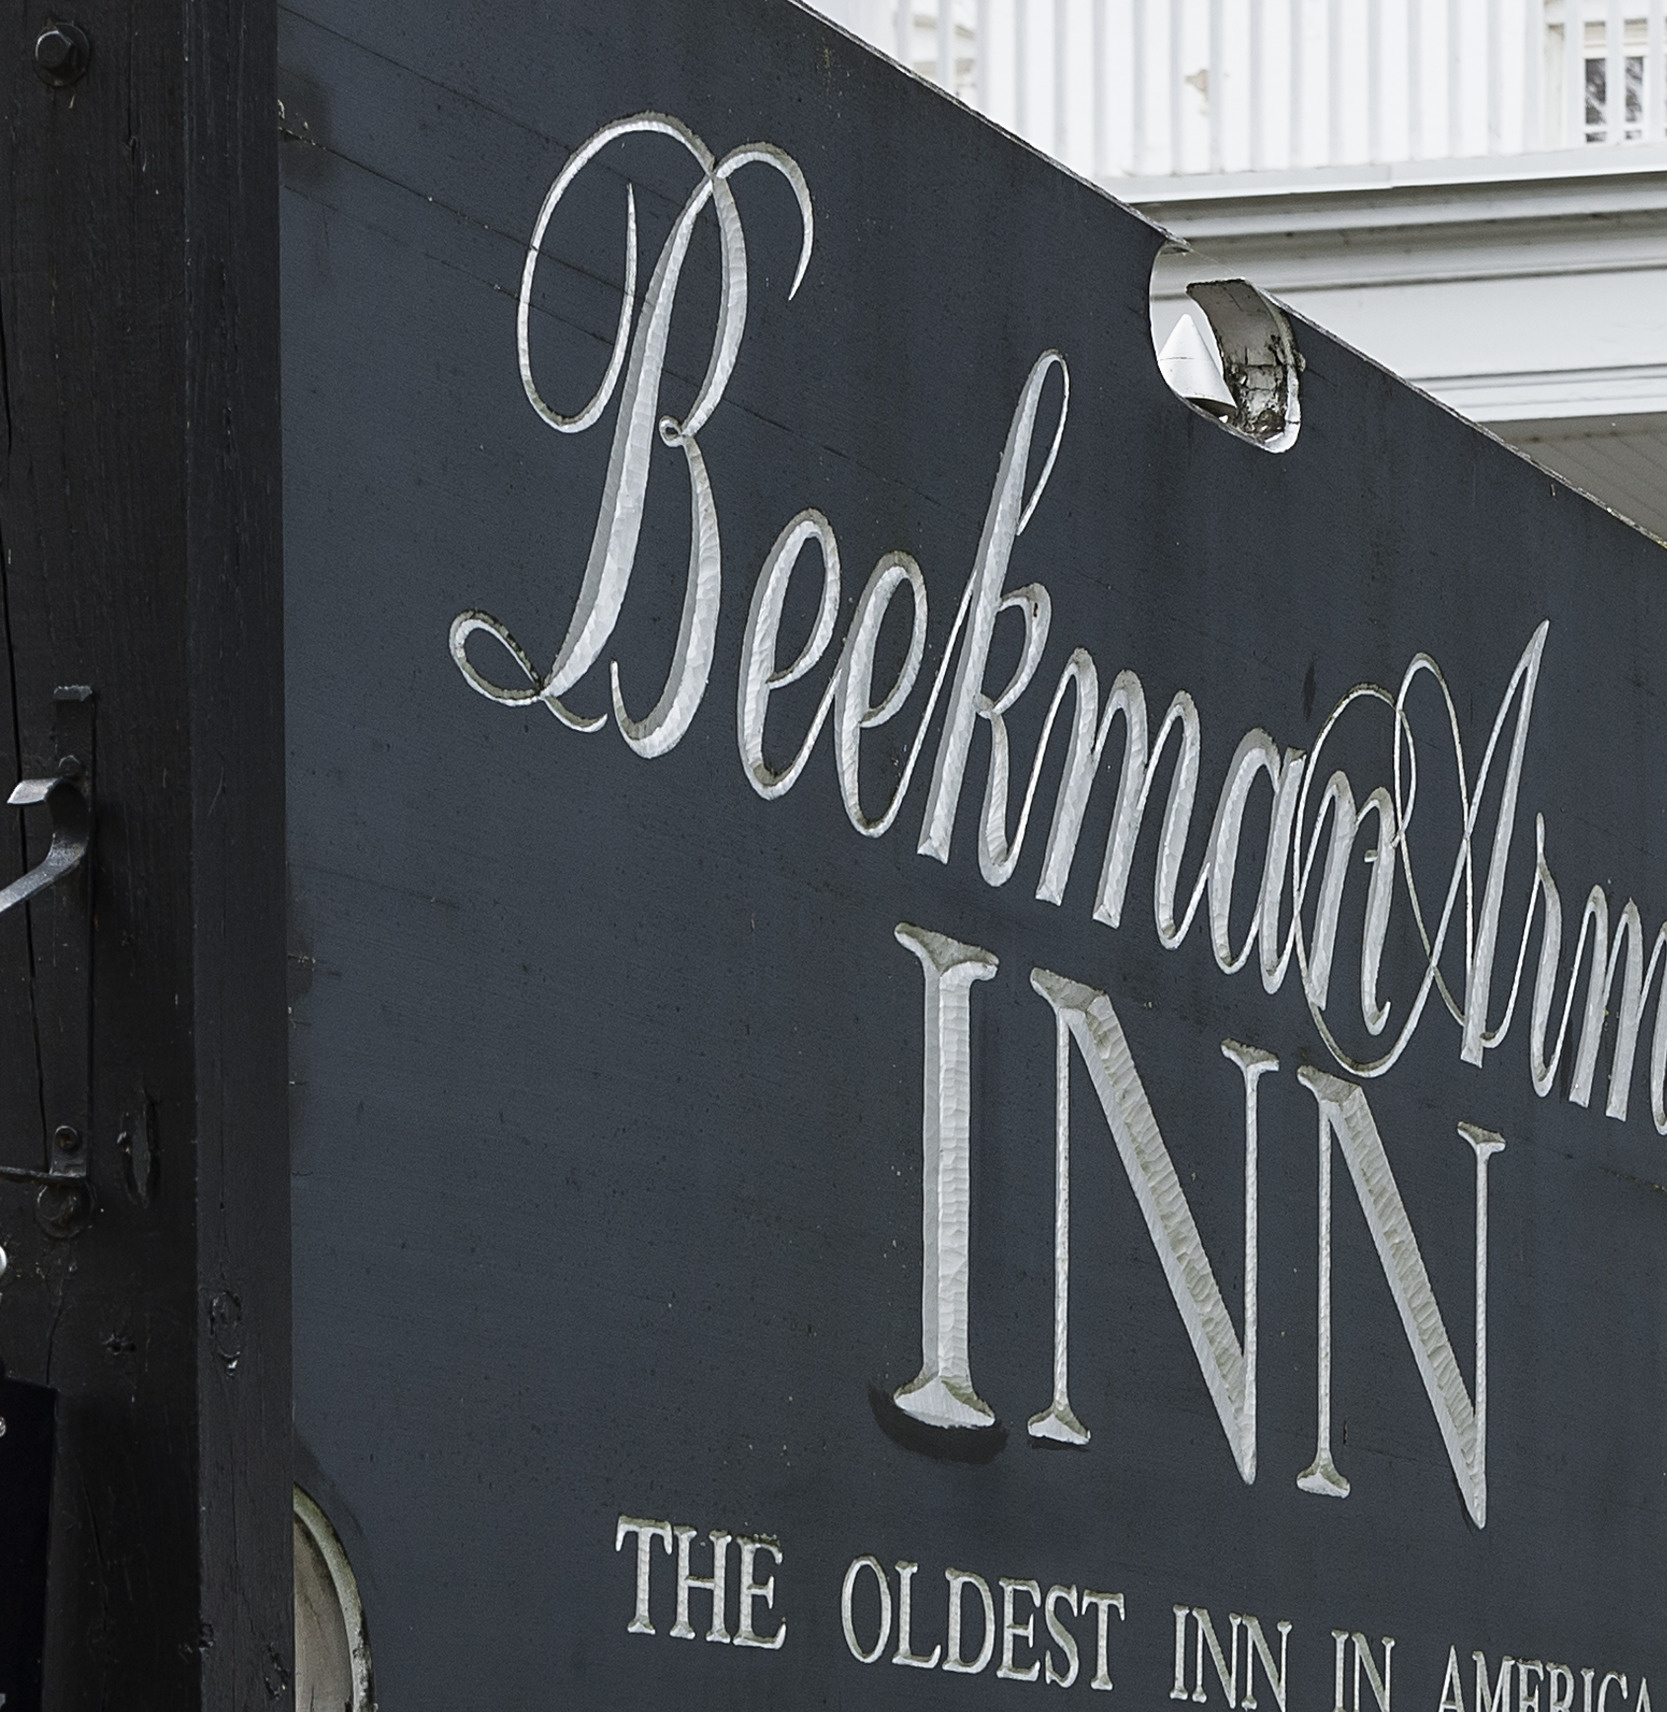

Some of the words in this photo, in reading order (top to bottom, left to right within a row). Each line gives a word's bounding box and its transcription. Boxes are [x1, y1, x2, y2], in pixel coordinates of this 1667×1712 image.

[447, 109, 1396, 1037] Beekman
[892, 921, 1507, 1531] INN
[614, 1514, 788, 1651] THE
[840, 1555, 1127, 1692] OLDEST
